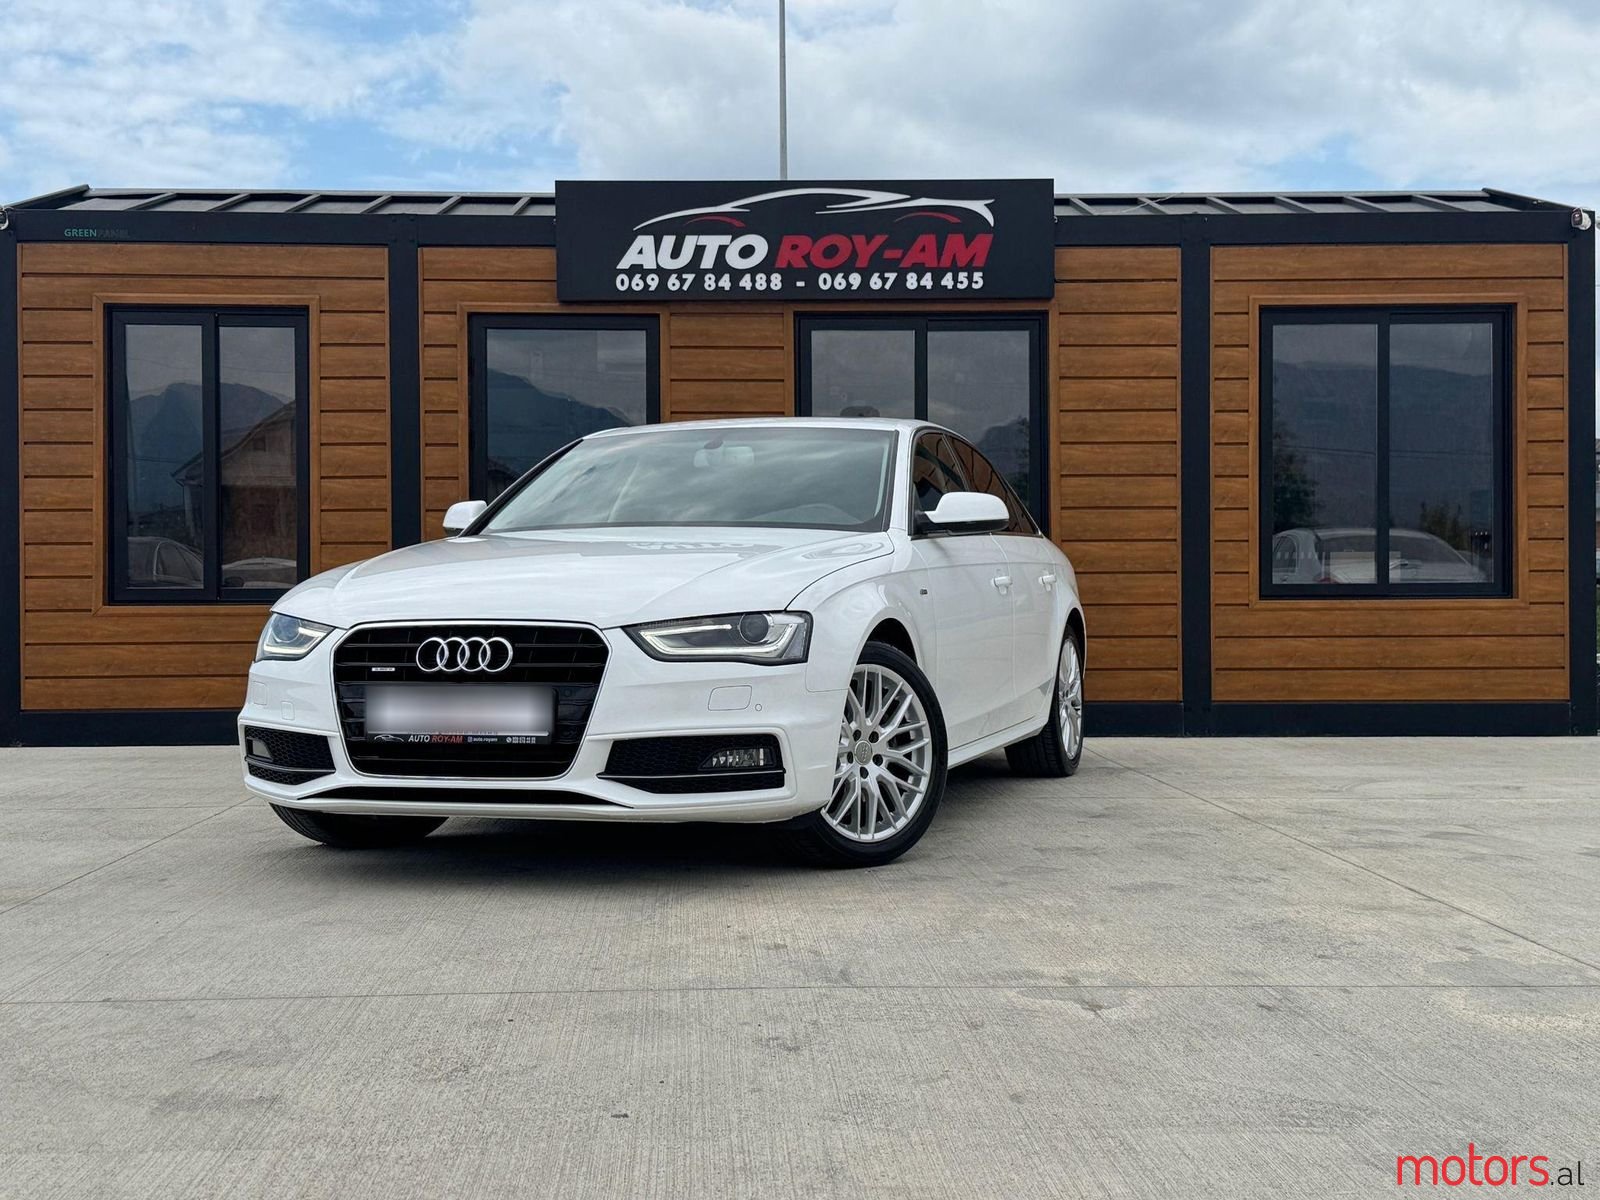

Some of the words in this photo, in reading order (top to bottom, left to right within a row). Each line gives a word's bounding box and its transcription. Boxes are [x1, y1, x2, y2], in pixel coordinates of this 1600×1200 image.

[616, 234, 769, 270] AUTO
[774, 233, 993, 269] ROY-AM
[615, 273, 660, 292] 069
[667, 273, 696, 292] 67
[703, 273, 732, 292] 84
[739, 273, 783, 292] 488
[818, 272, 863, 291] 069
[869, 272, 897, 291] 67
[905, 272, 933, 291] 84
[940, 272, 984, 291] 455
[408, 734, 430, 743] AUTO
[431, 735, 463, 744] ROY-AM
